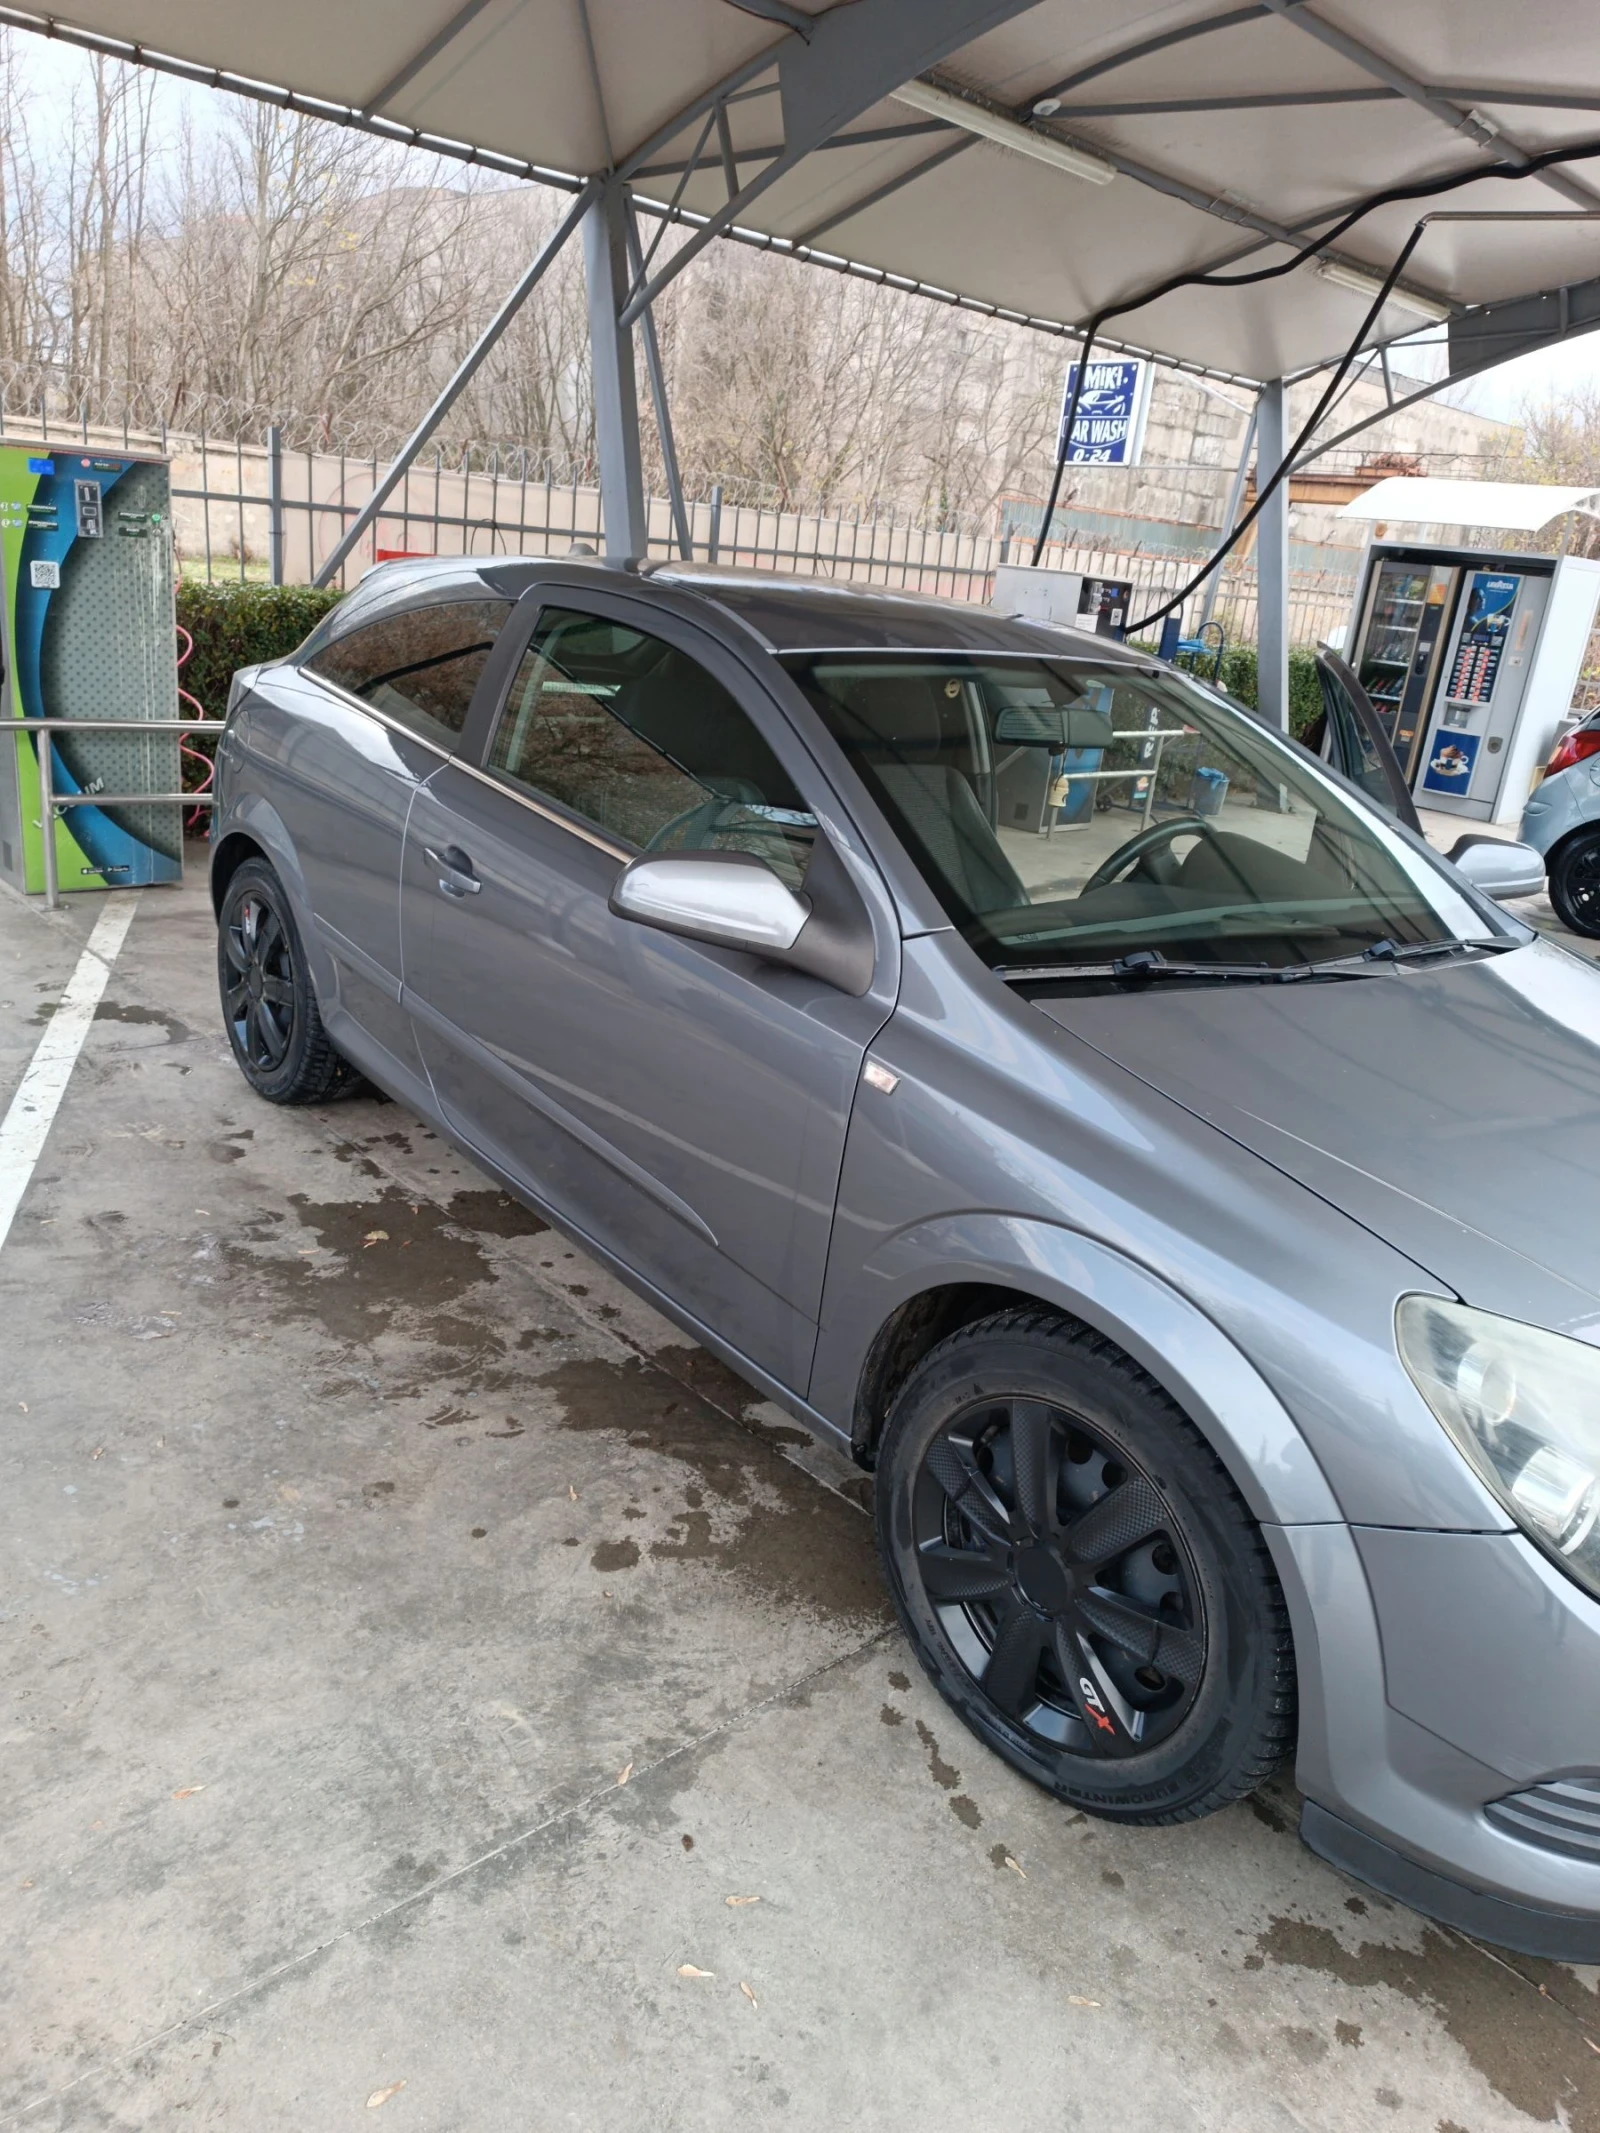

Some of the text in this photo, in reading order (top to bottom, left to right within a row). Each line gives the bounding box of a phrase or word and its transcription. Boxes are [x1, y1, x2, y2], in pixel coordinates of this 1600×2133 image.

[1084, 365, 1123, 389] MIKI
[1069, 420, 1128, 444] AR WASH
